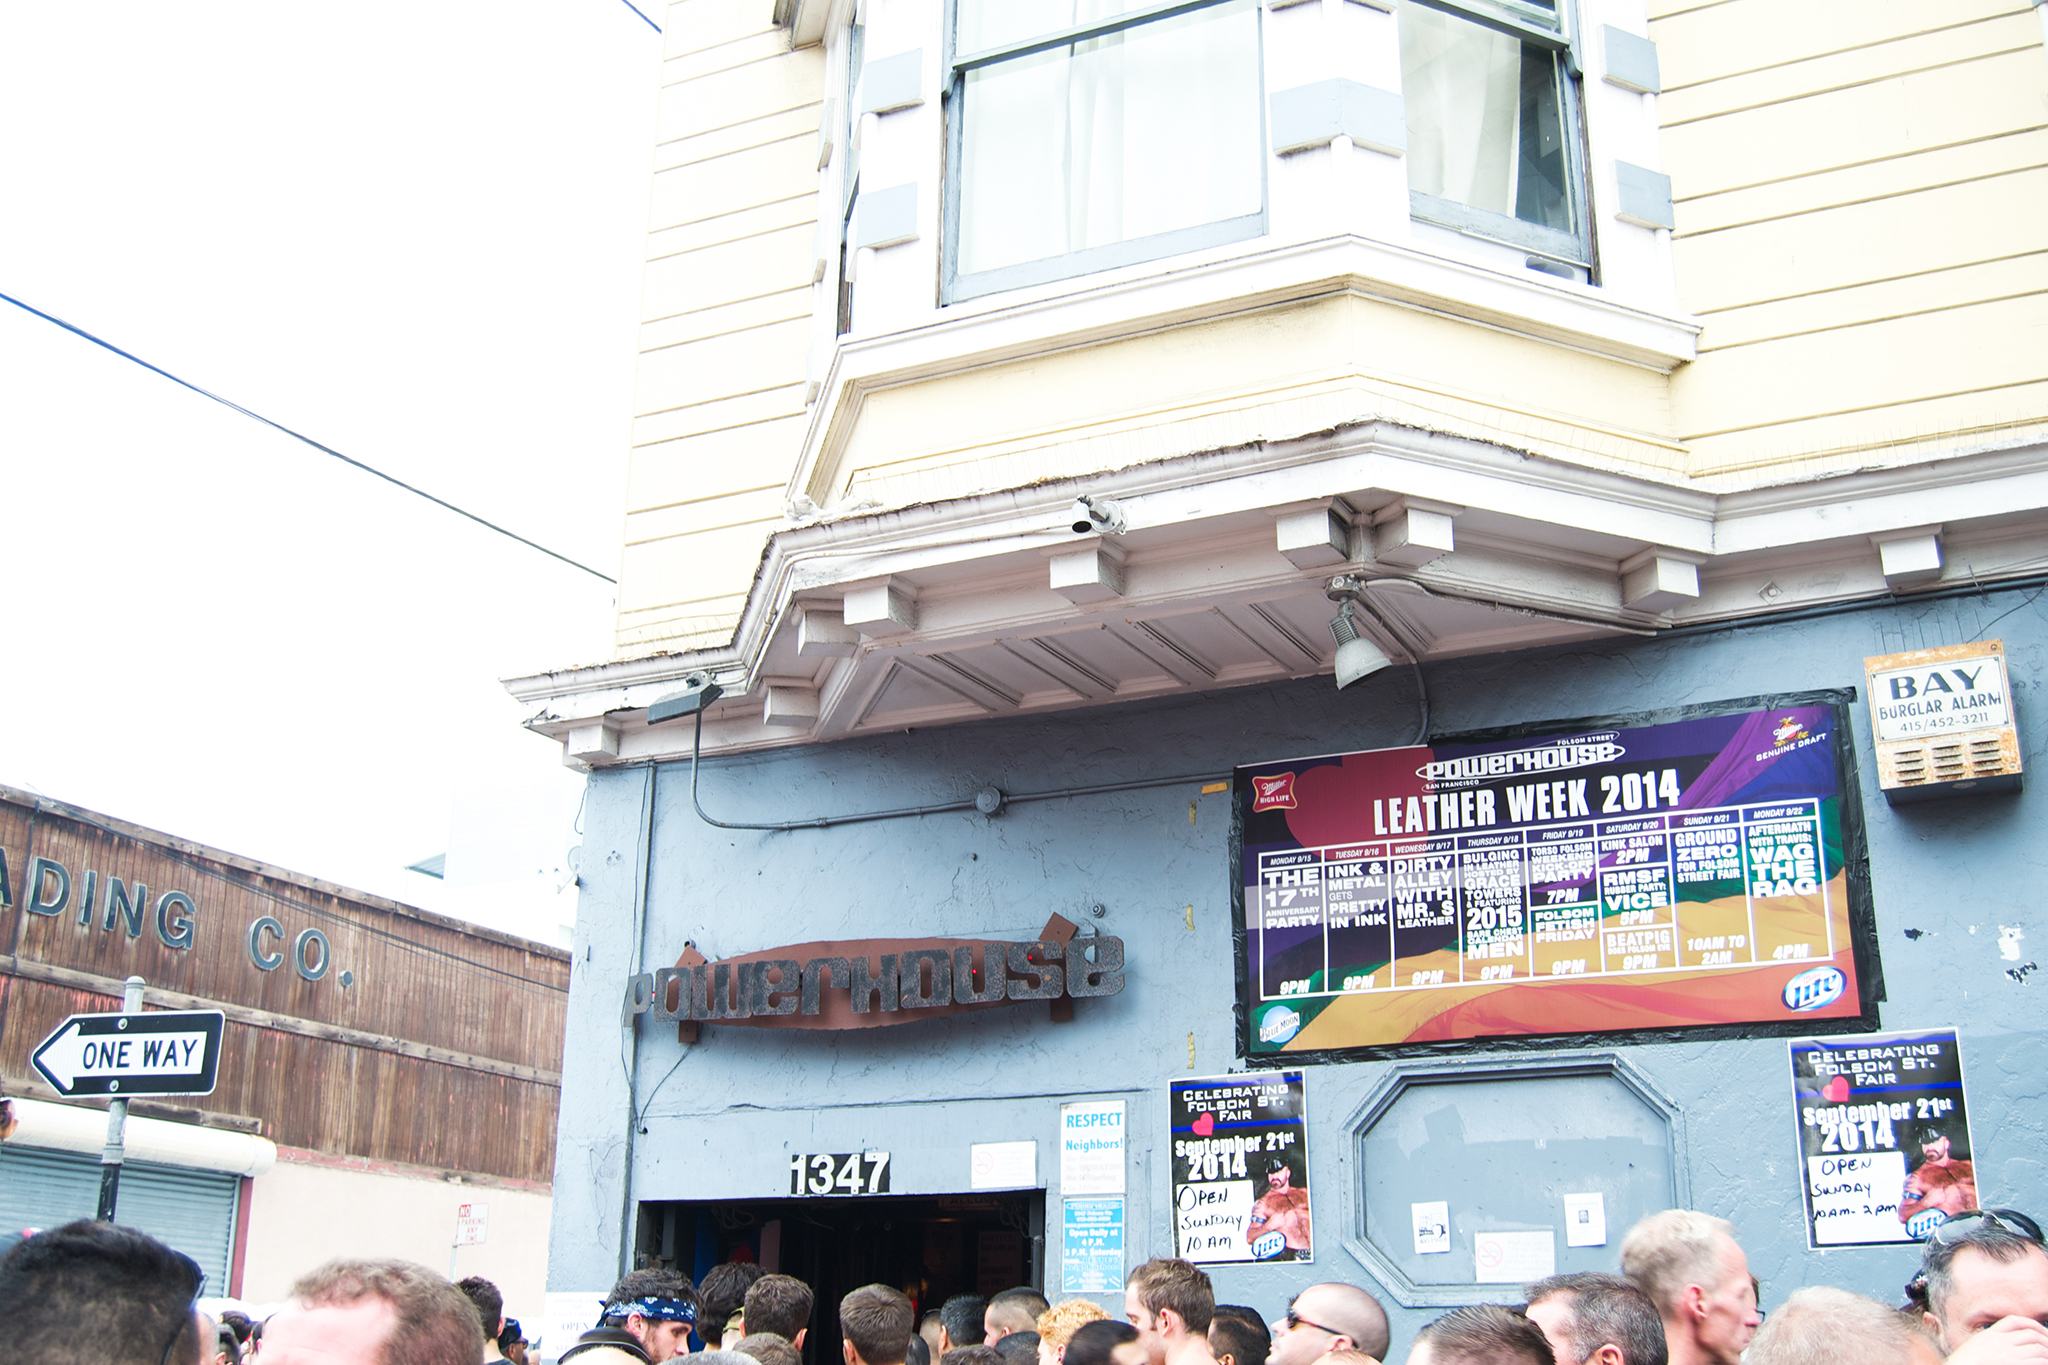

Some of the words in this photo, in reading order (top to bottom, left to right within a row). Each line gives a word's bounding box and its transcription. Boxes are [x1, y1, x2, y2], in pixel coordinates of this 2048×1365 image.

[1889, 666, 1982, 700] BAY
[1879, 699, 1943, 720] BURGLAR
[1952, 691, 2002, 711] ALARM
[1900, 712, 1988, 732] 415/452-3211
[1557, 737, 1586, 746] FOLSOM
[1586, 734, 1615, 743] STREET
[1772, 723, 1803, 741] Miller
[1756, 743, 1796, 761] GENUINE
[1798, 733, 1826, 748] DRAFT
[1261, 779, 1287, 796] Miller
[1426, 782, 1440, 790] SAN
[1441, 779, 1480, 789] FRANCISCO
[1260, 796, 1275, 804] HIGH
[1276, 794, 1290, 802] LIFE
[1374, 789, 1497, 836] LEATHER
[1506, 778, 1590, 823] WEEK
[1601, 768, 1680, 814] 2014
[1684, 816, 1712, 826] SUNDAY
[1713, 814, 1730, 824] 9/21
[1753, 808, 1785, 819] MONDAY
[1786, 807, 1804, 816] 9/22
[1543, 830, 1567, 840] FRIDAY
[1568, 829, 1584, 838] 9/19
[1606, 823, 1642, 834] SATURDAY
[1643, 820, 1659, 830] 9/20
[1748, 821, 1812, 837] AFTERMATH
[1467, 837, 1502, 847] THURSDAY
[1503, 835, 1519, 844] 9/18
[1601, 839, 1627, 851] KINK
[1628, 835, 1663, 848] SALON
[1675, 828, 1737, 848] GROUND
[1749, 836, 1774, 847] WITH
[1775, 833, 1812, 844] TRAVIS:
[1335, 850, 1363, 859] TUESDAY
[1364, 848, 1379, 857] 9/16
[1395, 844, 1433, 854] WEDNESDAY
[1435, 841, 1451, 850] 9/17
[1531, 845, 1558, 856] TORSO
[1560, 843, 1593, 854] FOLSOM
[1676, 844, 1738, 861] ZERO
[1749, 843, 1815, 863] WAG
[1270, 856, 1297, 866] MONDAY
[1297, 854, 1312, 863] 9/15
[1463, 849, 1520, 864] BULGING
[1532, 852, 1594, 865] WEEKEND
[1616, 848, 1650, 864] 2PM
[1328, 864, 1363, 878] INK
[1369, 862, 1384, 874] &
[1394, 856, 1452, 875] DIRTY
[1477, 861, 1519, 871] LEATHER
[1532, 860, 1594, 873] KICK-OFF
[1677, 862, 1696, 872] FOR
[1699, 858, 1739, 870] FOLSOM
[1751, 860, 1816, 881] THE
[1264, 868, 1320, 889] THE
[1395, 871, 1452, 889] ALLEY
[1464, 869, 1504, 878] HOSTED
[1533, 868, 1594, 884] PARTY
[1603, 869, 1666, 886] RMSF
[1677, 871, 1715, 883] STREET
[1717, 868, 1741, 880] FAIR
[1329, 876, 1386, 891] METAL
[1465, 874, 1521, 890] GRACE
[1604, 885, 1636, 896] RUBBER
[1638, 882, 1666, 893] PARTY:
[1752, 878, 1817, 899] RAG
[1329, 891, 1353, 901] GETS
[1396, 886, 1452, 904] WITH
[1465, 886, 1521, 900] TOWERS
[1547, 888, 1579, 904] 7PM
[1330, 899, 1386, 915] PRETTY
[1397, 903, 1435, 919] MR.
[1442, 900, 1455, 916] S
[1475, 897, 1521, 907] FEATURING
[1605, 893, 1668, 912] VICE
[1266, 906, 1320, 917] ANNIVERSARY
[1466, 905, 1522, 931] 2015
[1535, 908, 1594, 921] FOLSOM
[1620, 910, 1654, 925] 5PM
[1266, 914, 1320, 929] PARTY
[1331, 917, 1349, 929] IN
[1355, 913, 1387, 927] INK
[1398, 917, 1454, 929] LEATHER
[1536, 918, 1596, 932] FETISH
[1467, 930, 1491, 939] BARE
[1493, 927, 1523, 936] CHEST
[1467, 934, 1523, 945] CALENDAR
[1536, 929, 1596, 943] FRIDAY
[1606, 930, 1671, 948] BEATPIG
[1467, 941, 1524, 960] MEN
[1607, 947, 1626, 955] DOES
[1627, 945, 1656, 954] FOLSOM
[1687, 936, 1727, 951] 10AM
[1728, 934, 1746, 948] TO
[249, 916, 353, 987] CO.
[1701, 950, 1733, 966] 2AM
[1772, 943, 1809, 960] 4PM
[1552, 959, 1586, 975] 9PM
[1622, 954, 1658, 970] 9PM
[1412, 970, 1444, 985] 9PM
[1480, 964, 1513, 980] 9PM
[1280, 979, 1311, 995] 9PM
[1343, 974, 1375, 990] 9PM
[82, 1042, 132, 1069] ONE
[143, 1039, 198, 1067] WAY
[1807, 1044, 1940, 1064] CELEBRATING
[1815, 1060, 1893, 1076] FOLSOM
[1902, 1056, 1936, 1070] ST.
[1855, 1073, 1897, 1086] FAIR
[1183, 1084, 1289, 1102] CELEBRATING
[1187, 1098, 1250, 1113] FOLSOM
[1257, 1095, 1284, 1107] ST.
[1803, 1101, 1911, 1126] September
[1916, 1098, 1953, 1119] 21st
[1066, 1112, 1123, 1128] RESPECT
[1219, 1110, 1252, 1121] FAIR
[1175, 1135, 1262, 1157] September
[1266, 1131, 1294, 1151] 21st
[1821, 1120, 1896, 1152] 2014
[1065, 1137, 1123, 1153] Neighbors!
[790, 1152, 890, 1195] 1347
[1188, 1152, 1247, 1181] 2014
[1822, 1158, 1872, 1175] OPEN
[1178, 1186, 1228, 1211] OPEN
[460, 1206, 471, 1216] NO
[461, 1217, 485, 1225] PARKING
[1069, 1229, 1088, 1238] Open
[1090, 1229, 1108, 1238] Daily
[1082, 1238, 1087, 1246] 4
[1090, 1248, 1122, 1257] Saturday
[562, 1322, 590, 1331] OPEN
